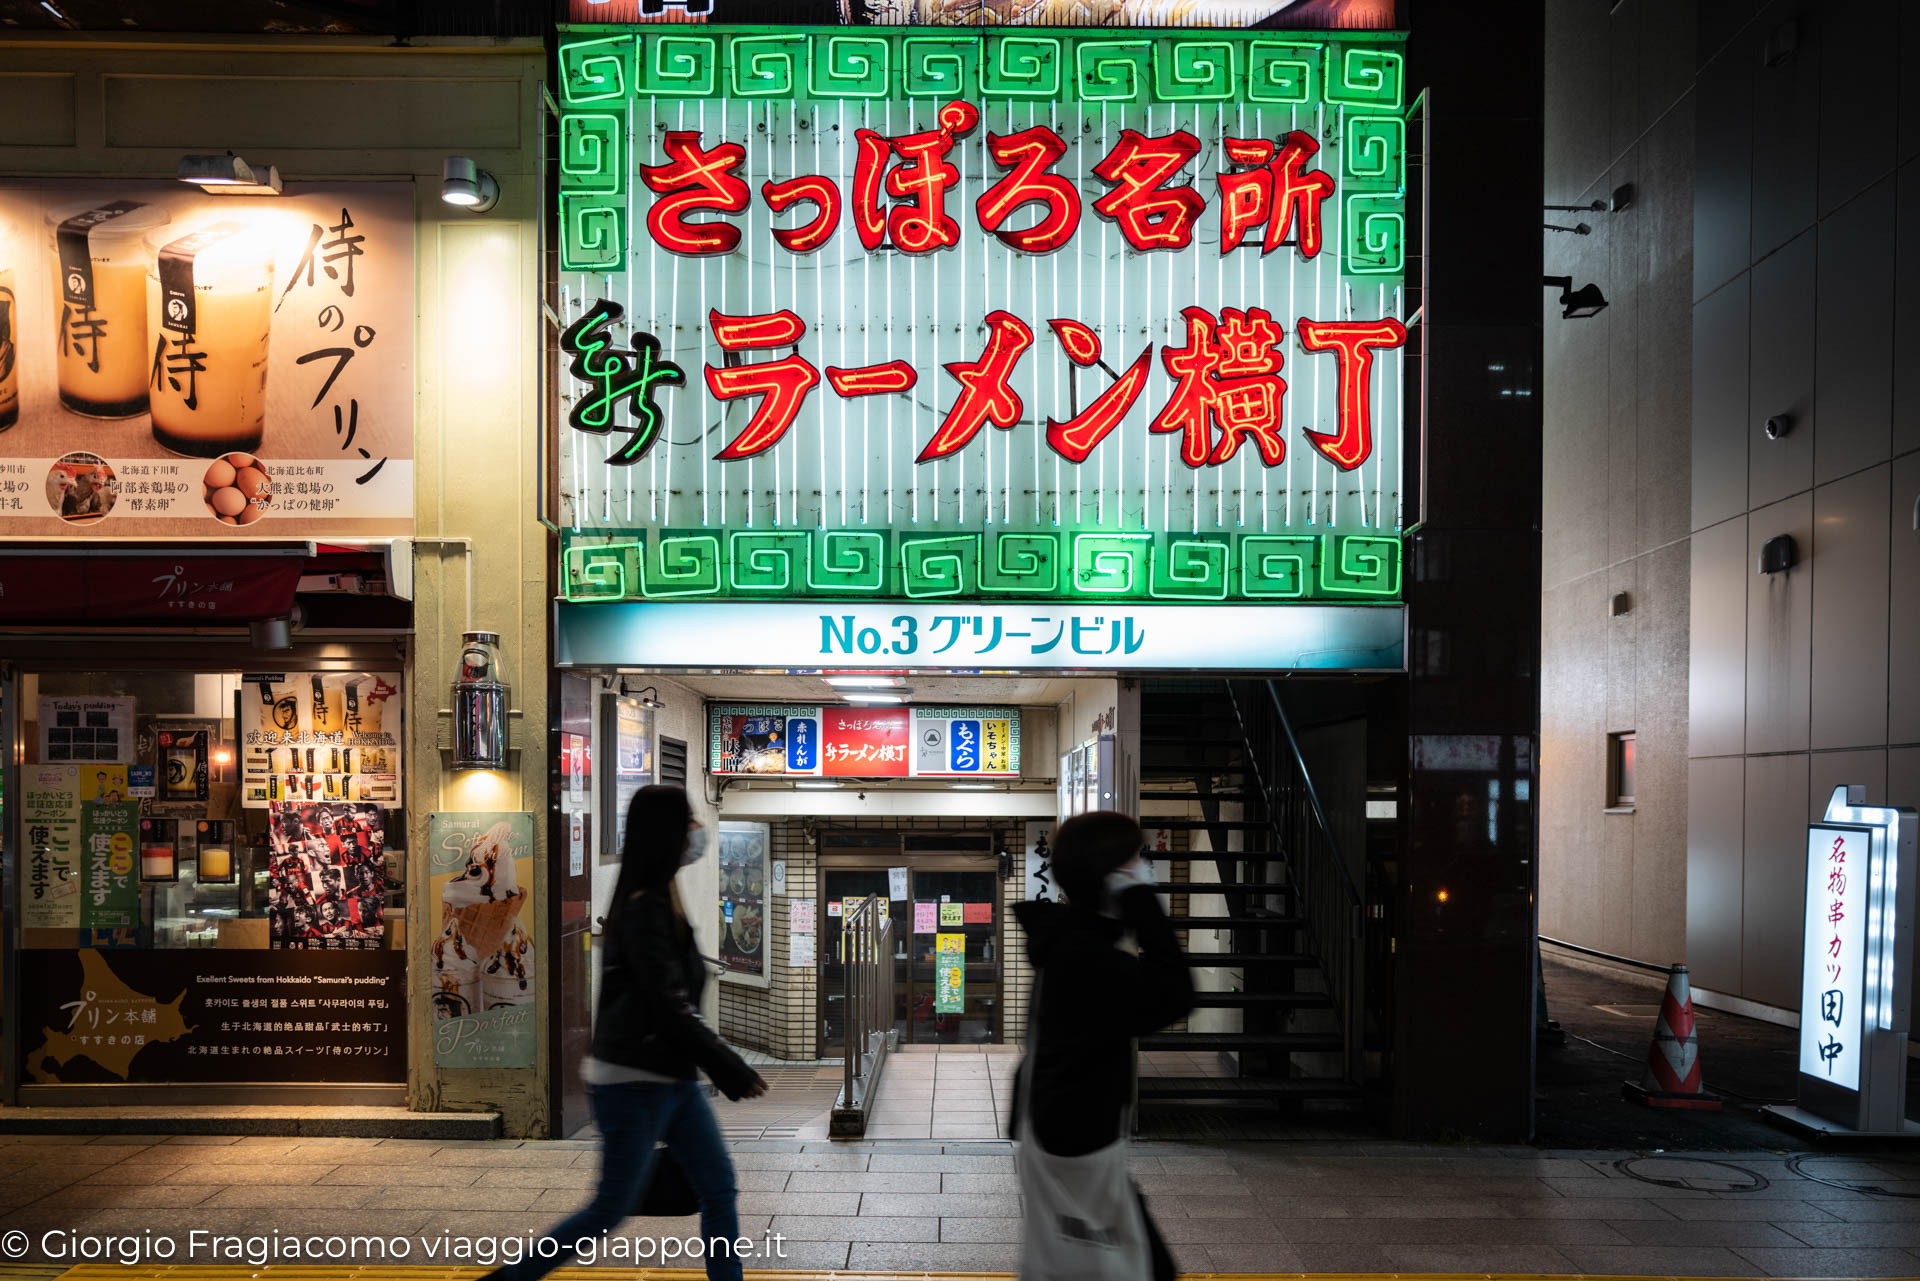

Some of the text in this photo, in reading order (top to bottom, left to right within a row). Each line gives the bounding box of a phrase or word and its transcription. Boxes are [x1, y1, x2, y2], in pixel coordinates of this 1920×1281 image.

[640, 99, 1335, 262] さっぽろ名所
[58, 301, 108, 373] 侍
[275, 207, 388, 485] 侍のプリン
[150, 332, 208, 411] 侍
[560, 297, 1406, 472] 新ラーメン横丁
[0, 480, 29, 494] 場の
[111, 481, 189, 495] 阿部養鶏場の
[120, 465, 179, 476] 北海道下川町
[257, 482, 334, 495] 大熊養鶏場の
[266, 466, 324, 476] 北海道比布町
[820, 615, 1145, 655] No.3 グリーンビル
[53, 701, 116, 712] Today's pudding
[247, 729, 345, 747] 欢迎来北海道
[796, 721, 809, 767] 赤れんが
[825, 742, 907, 762] 新ラーメン横丁
[955, 722, 976, 769] もぐら
[986, 722, 998, 770] いそちゃん
[26, 791, 73, 800] ほっかいどう
[34, 809, 67, 818] クーポン
[442, 820, 480, 829] Samurai
[29, 825, 50, 900] 使えます
[52, 826, 71, 882] ここで
[88, 832, 112, 906] 使えます
[113, 835, 131, 888] ここで
[1817, 835, 1847, 1077] 名物串カツ 田中
[940, 967, 952, 1005] 使えます
[59, 991, 157, 1029] プリン本舗
[80, 1034, 146, 1046] すすきの店
[436, 1009, 529, 1055] Parfait
